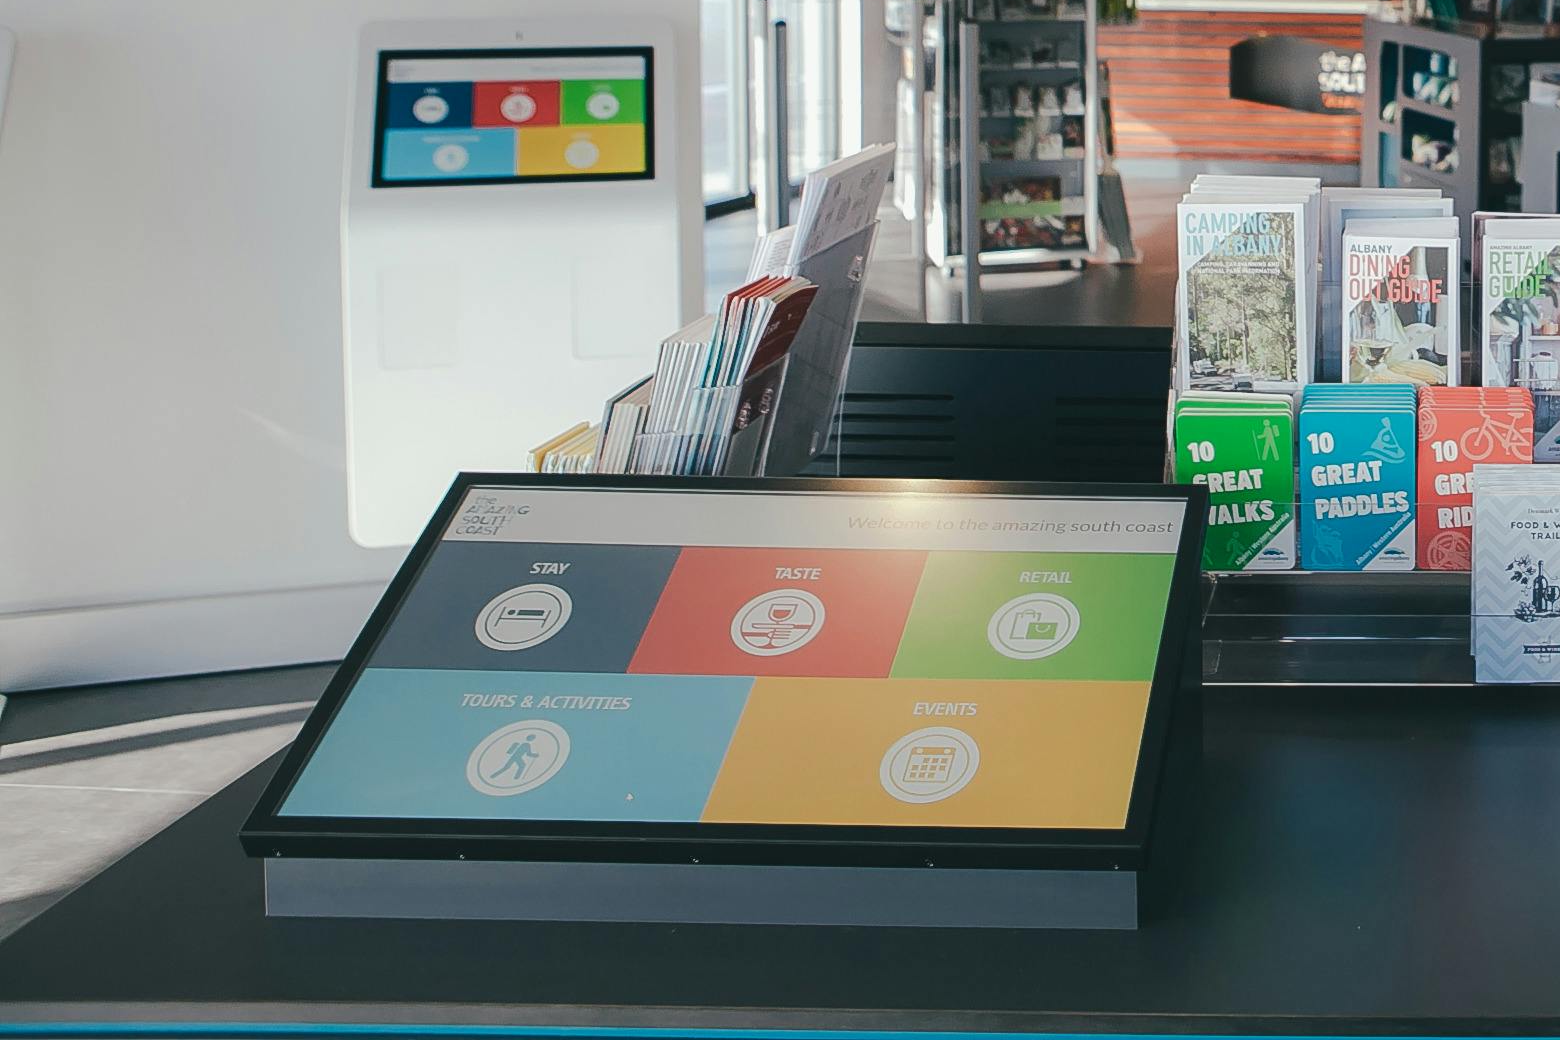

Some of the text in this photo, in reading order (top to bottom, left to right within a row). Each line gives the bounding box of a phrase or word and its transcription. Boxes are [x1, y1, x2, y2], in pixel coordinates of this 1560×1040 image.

[1185, 212, 1270, 234] CAMPING
[1186, 236, 1282, 257] IN ALBANY
[1350, 244, 1393, 254] ALBANY
[1350, 254, 1411, 279] DINING
[1489, 251, 1552, 275] RETAIL
[1349, 278, 1443, 304] OUT GUIDE
[1489, 275, 1546, 298] GUIDE
[1187, 441, 1215, 463] 10
[1306, 432, 1334, 455] 10
[1430, 440, 1458, 463] 10
[1193, 468, 1263, 493] GREAT
[1311, 460, 1382, 487] GREAT
[1434, 472, 1474, 496] GRE
[1315, 491, 1410, 520] PADDLES
[462, 515, 511, 525] SOUTH
[848, 516, 1174, 535] Welcome to the amazing south coast
[1437, 506, 1473, 529] RID
[1510, 521, 1541, 530] FOOD
[455, 525, 501, 536] COAST
[1531, 532, 1560, 540] TRAIL
[530, 563, 572, 575] STAY
[774, 567, 822, 581] TASTE
[1019, 571, 1073, 584] RETAIL
[461, 693, 633, 710] TOURS & ACTIVITIES
[912, 702, 978, 716] EVENTS
